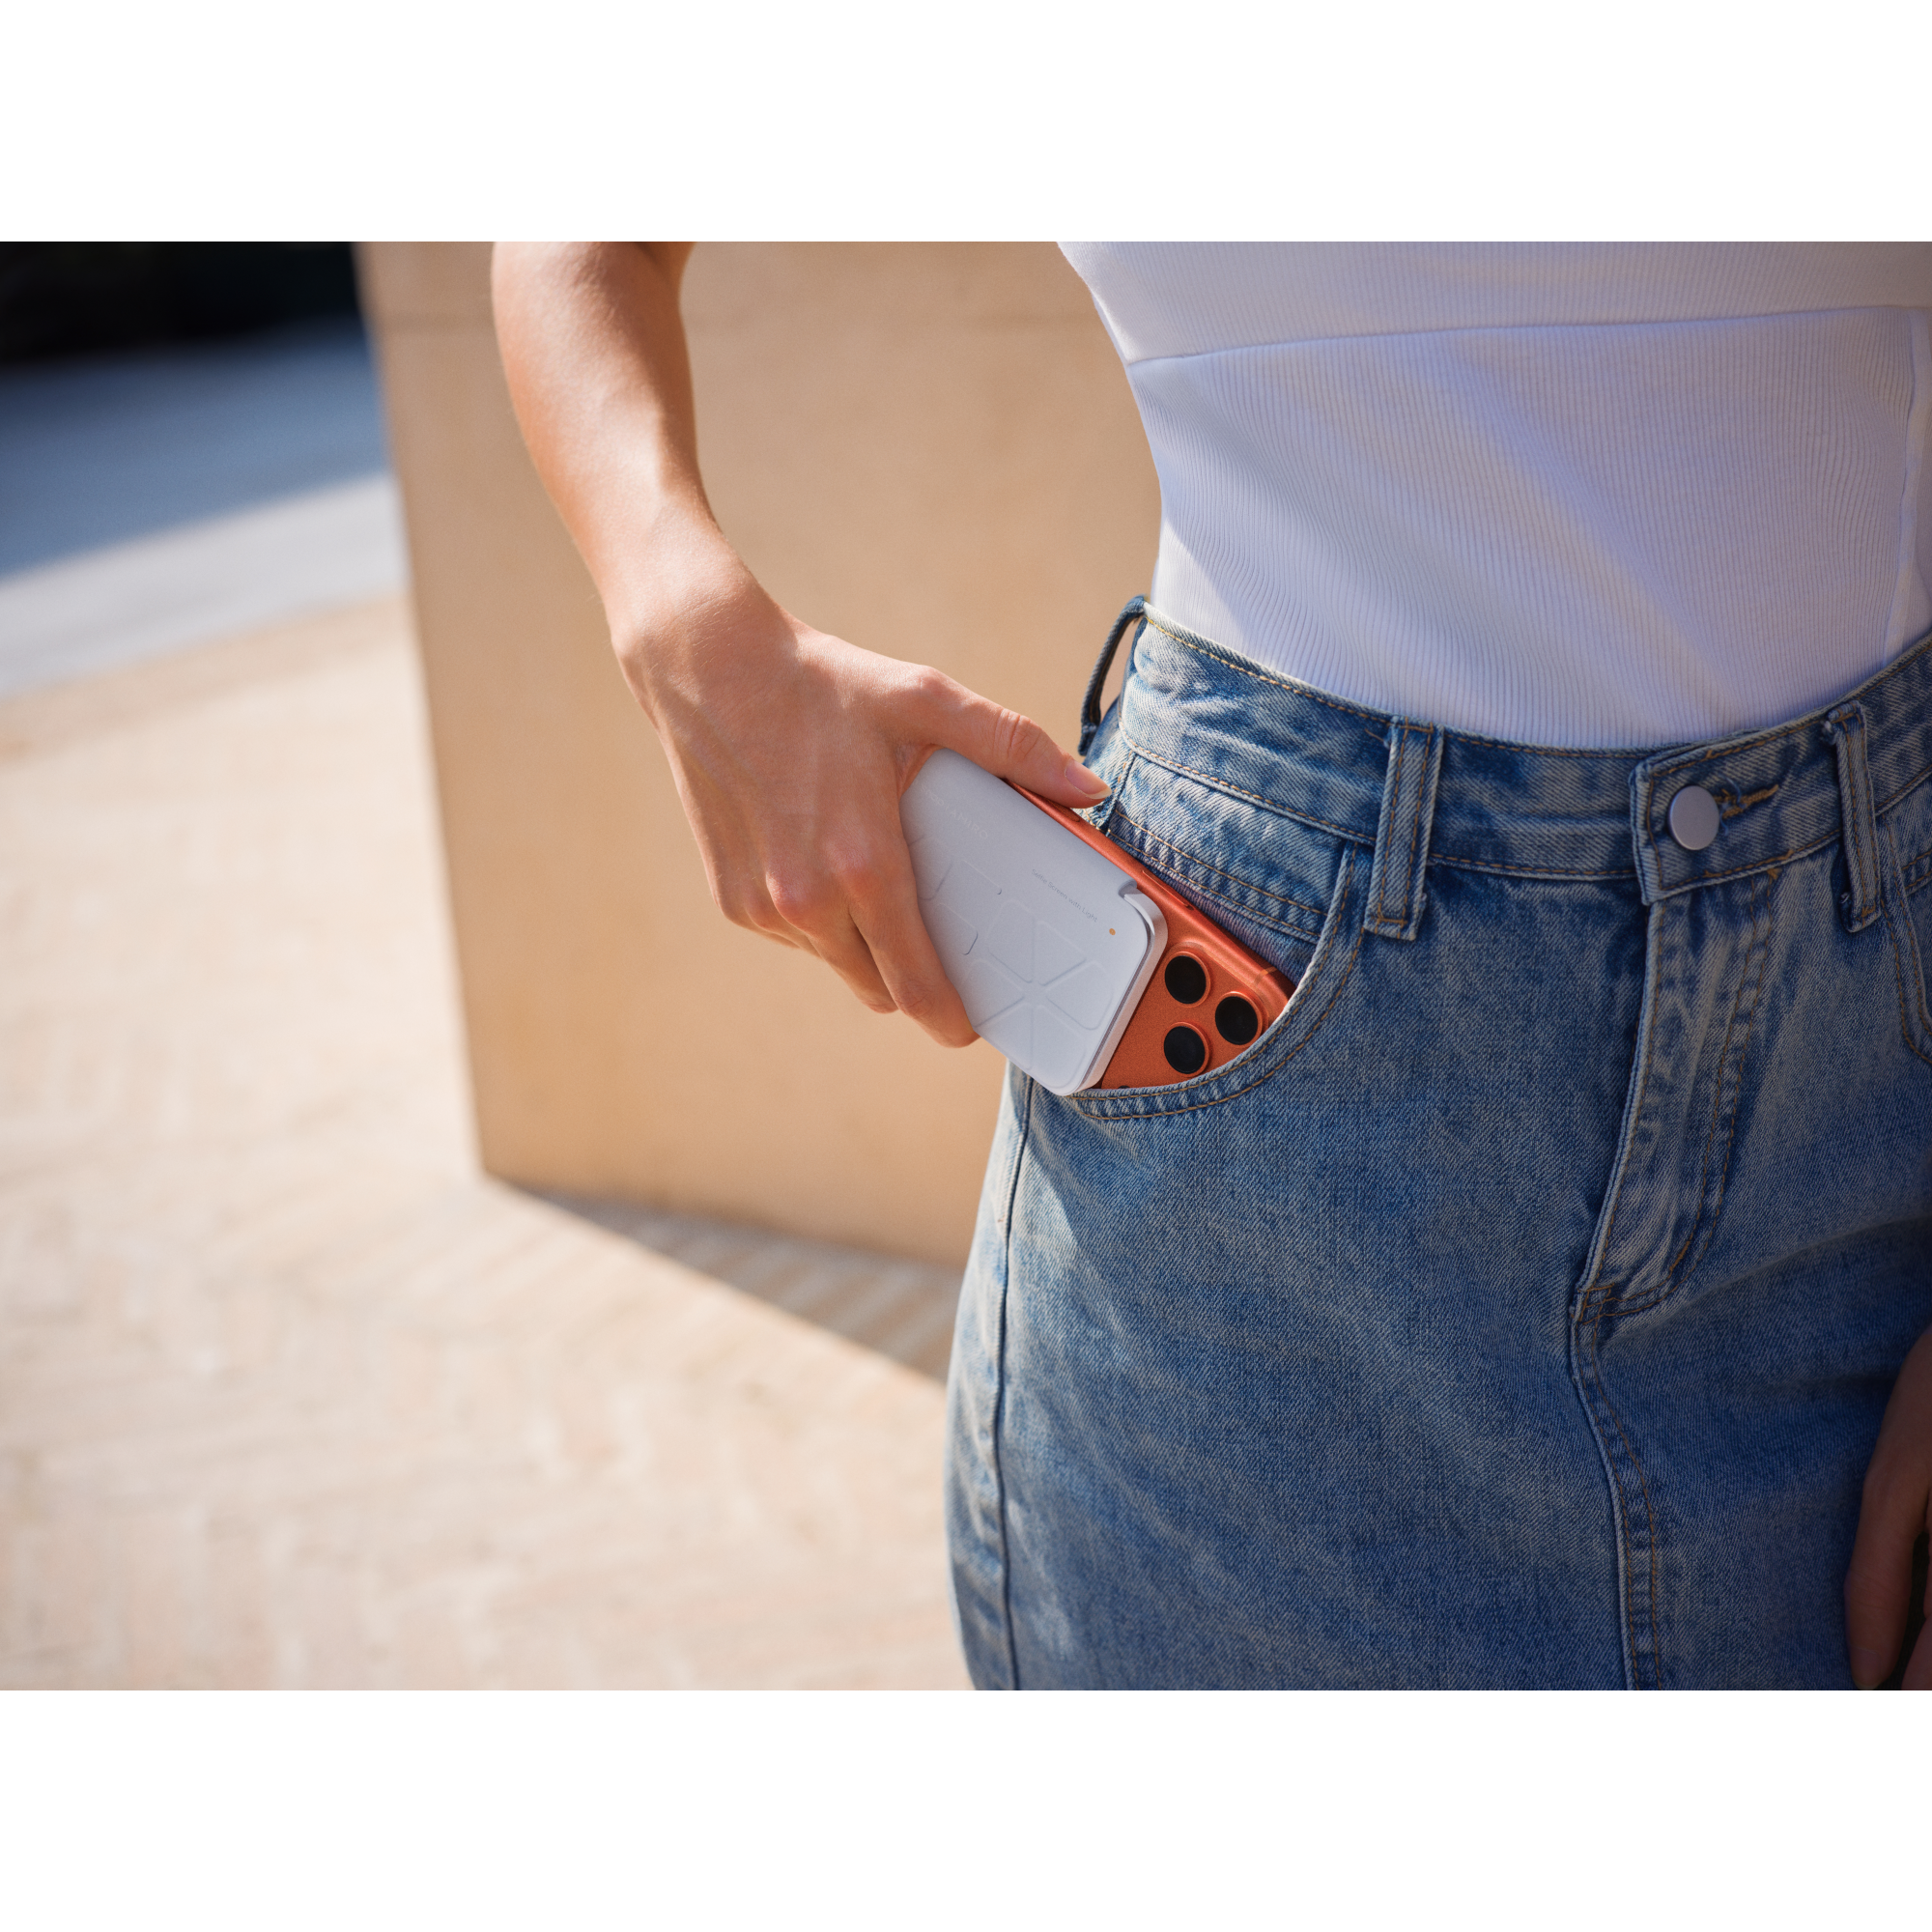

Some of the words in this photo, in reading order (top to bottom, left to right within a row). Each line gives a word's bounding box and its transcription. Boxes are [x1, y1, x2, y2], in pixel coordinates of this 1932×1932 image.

[1047, 881, 1068, 900] Screen
[1068, 896, 1082, 910] with
[1081, 907, 1098, 923] Light
